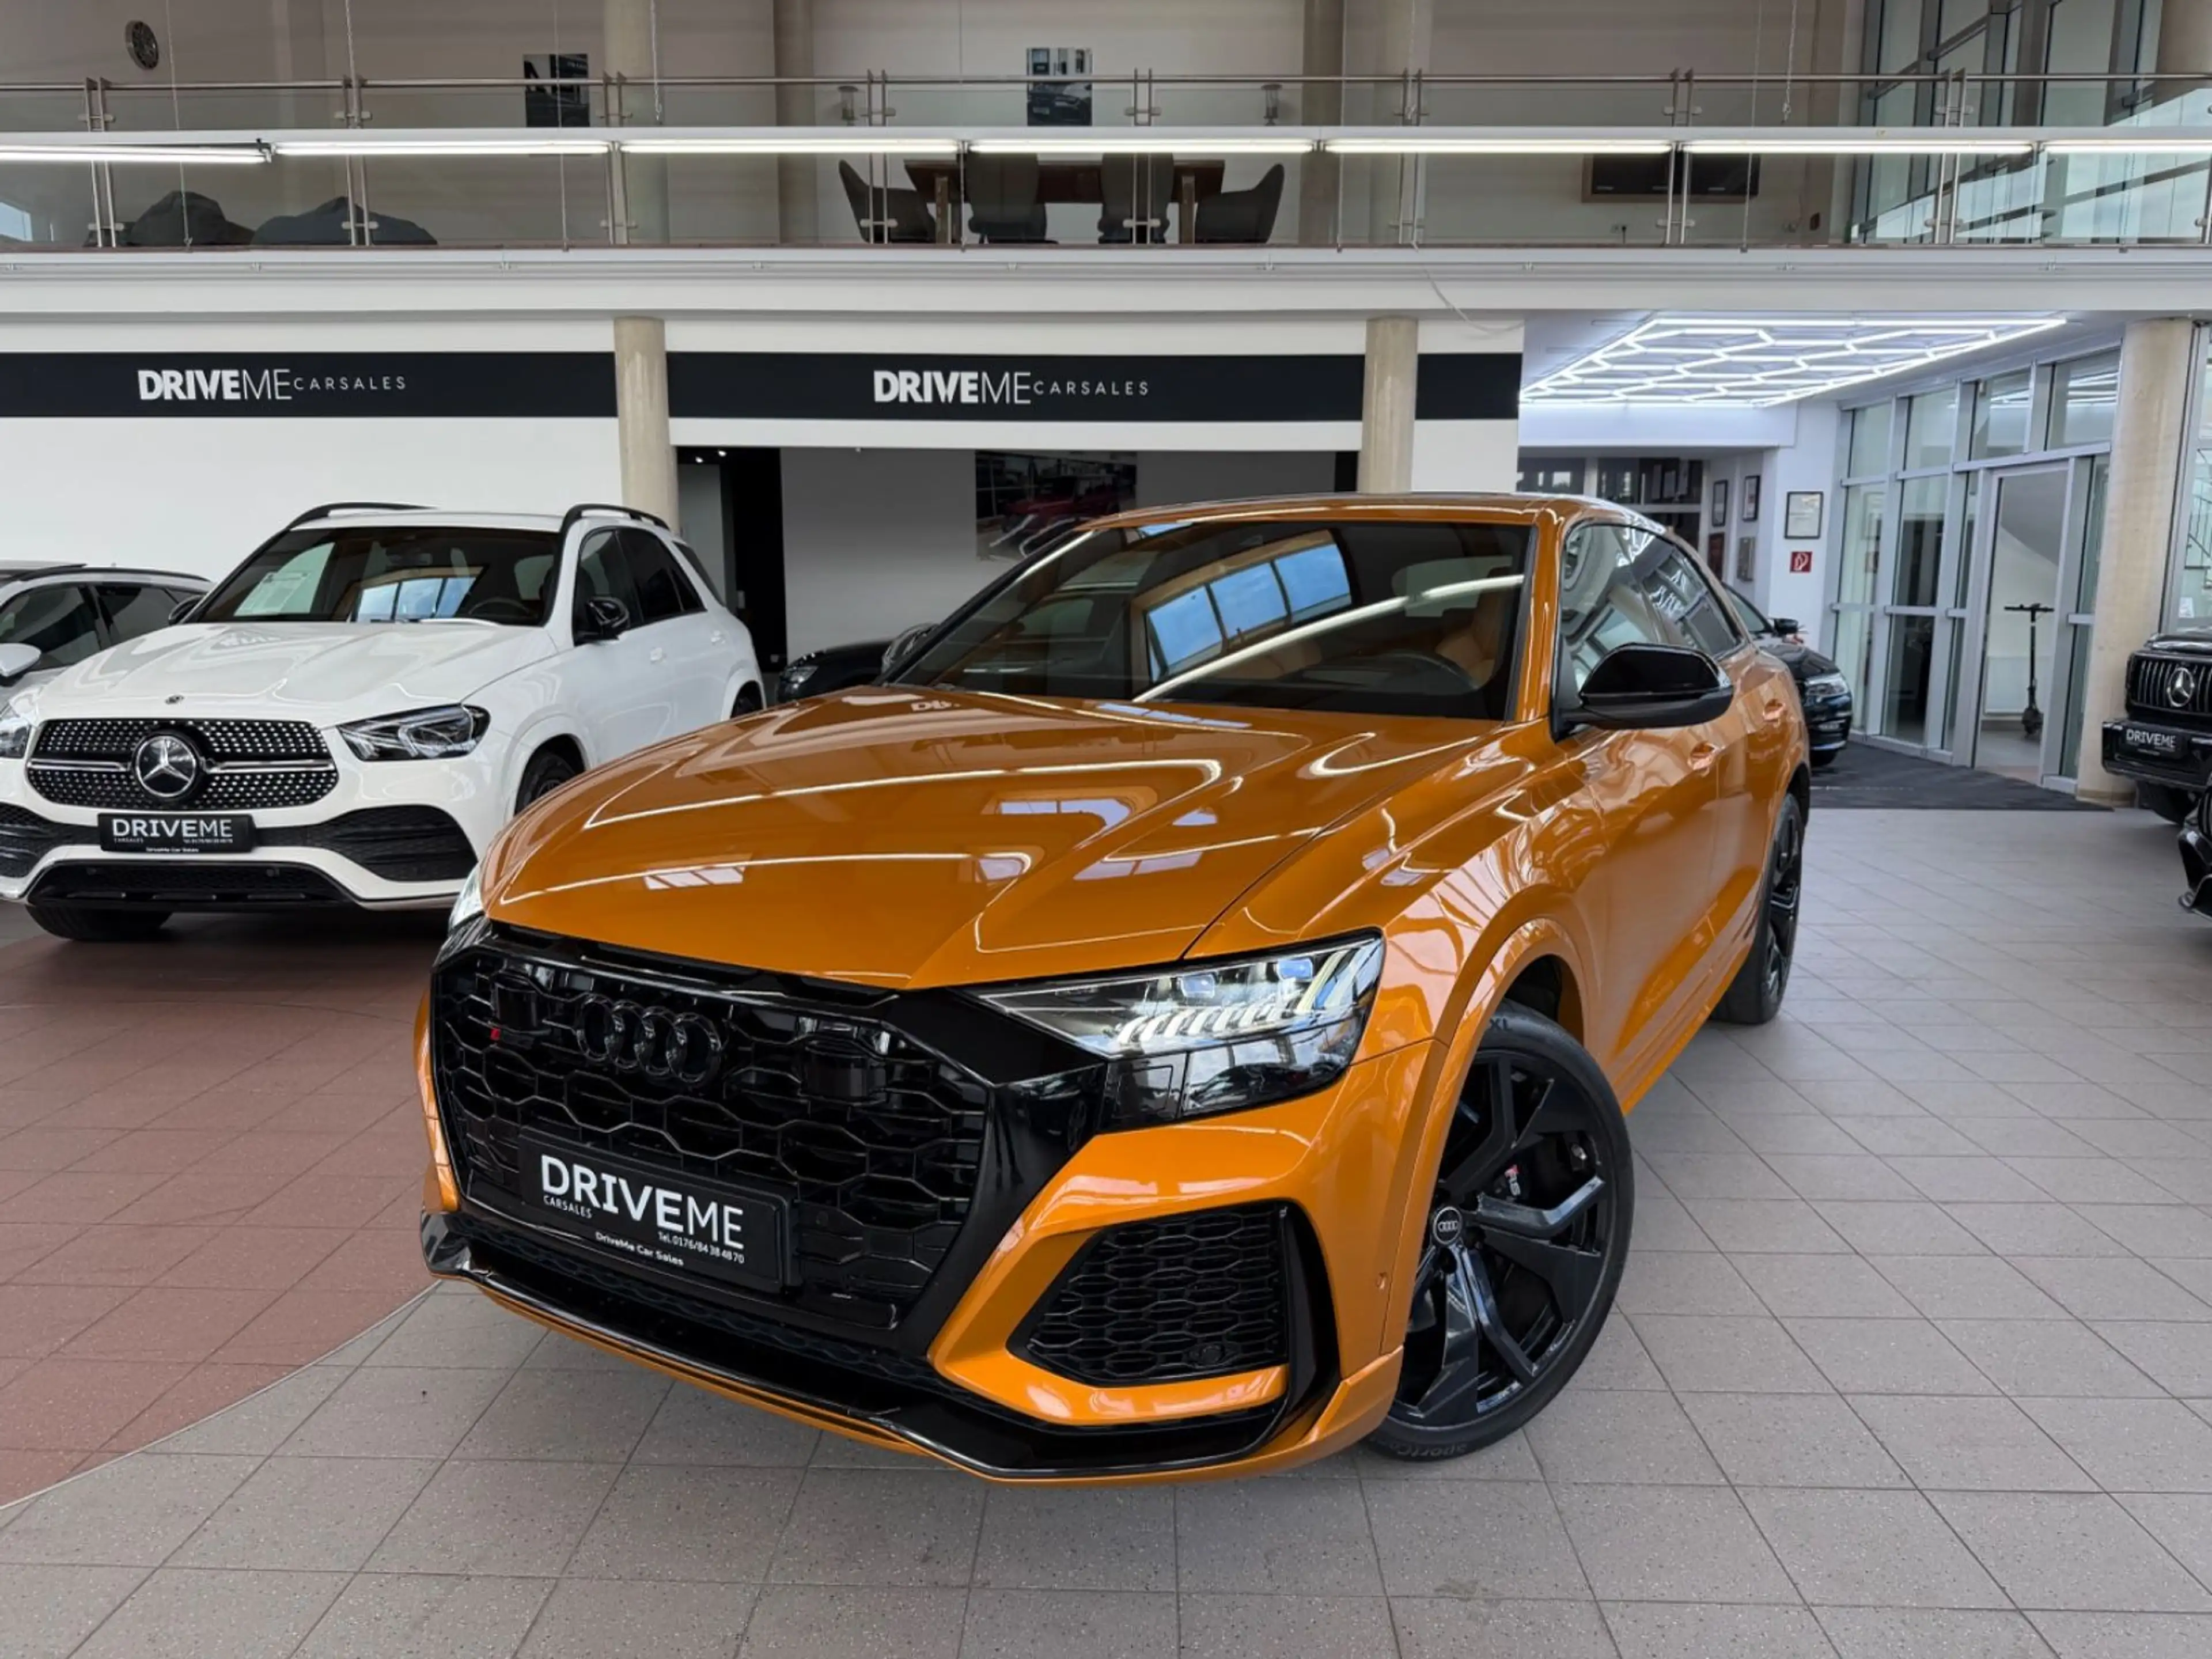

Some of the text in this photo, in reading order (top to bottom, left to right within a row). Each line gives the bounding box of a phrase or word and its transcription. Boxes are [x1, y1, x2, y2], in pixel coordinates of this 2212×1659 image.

[294, 376, 406, 390] CARSALES
[1033, 381, 1149, 395] CARSALES
[2126, 729, 2177, 748] DRIVEME
[112, 819, 233, 837] DRIVEME
[1488, 1017, 1513, 1031] XL
[541, 1154, 744, 1249] DRIVEME
[543, 1195, 593, 1219] CARSALES
[637, 1244, 654, 1257] Car
[654, 1249, 684, 1267] Sales
